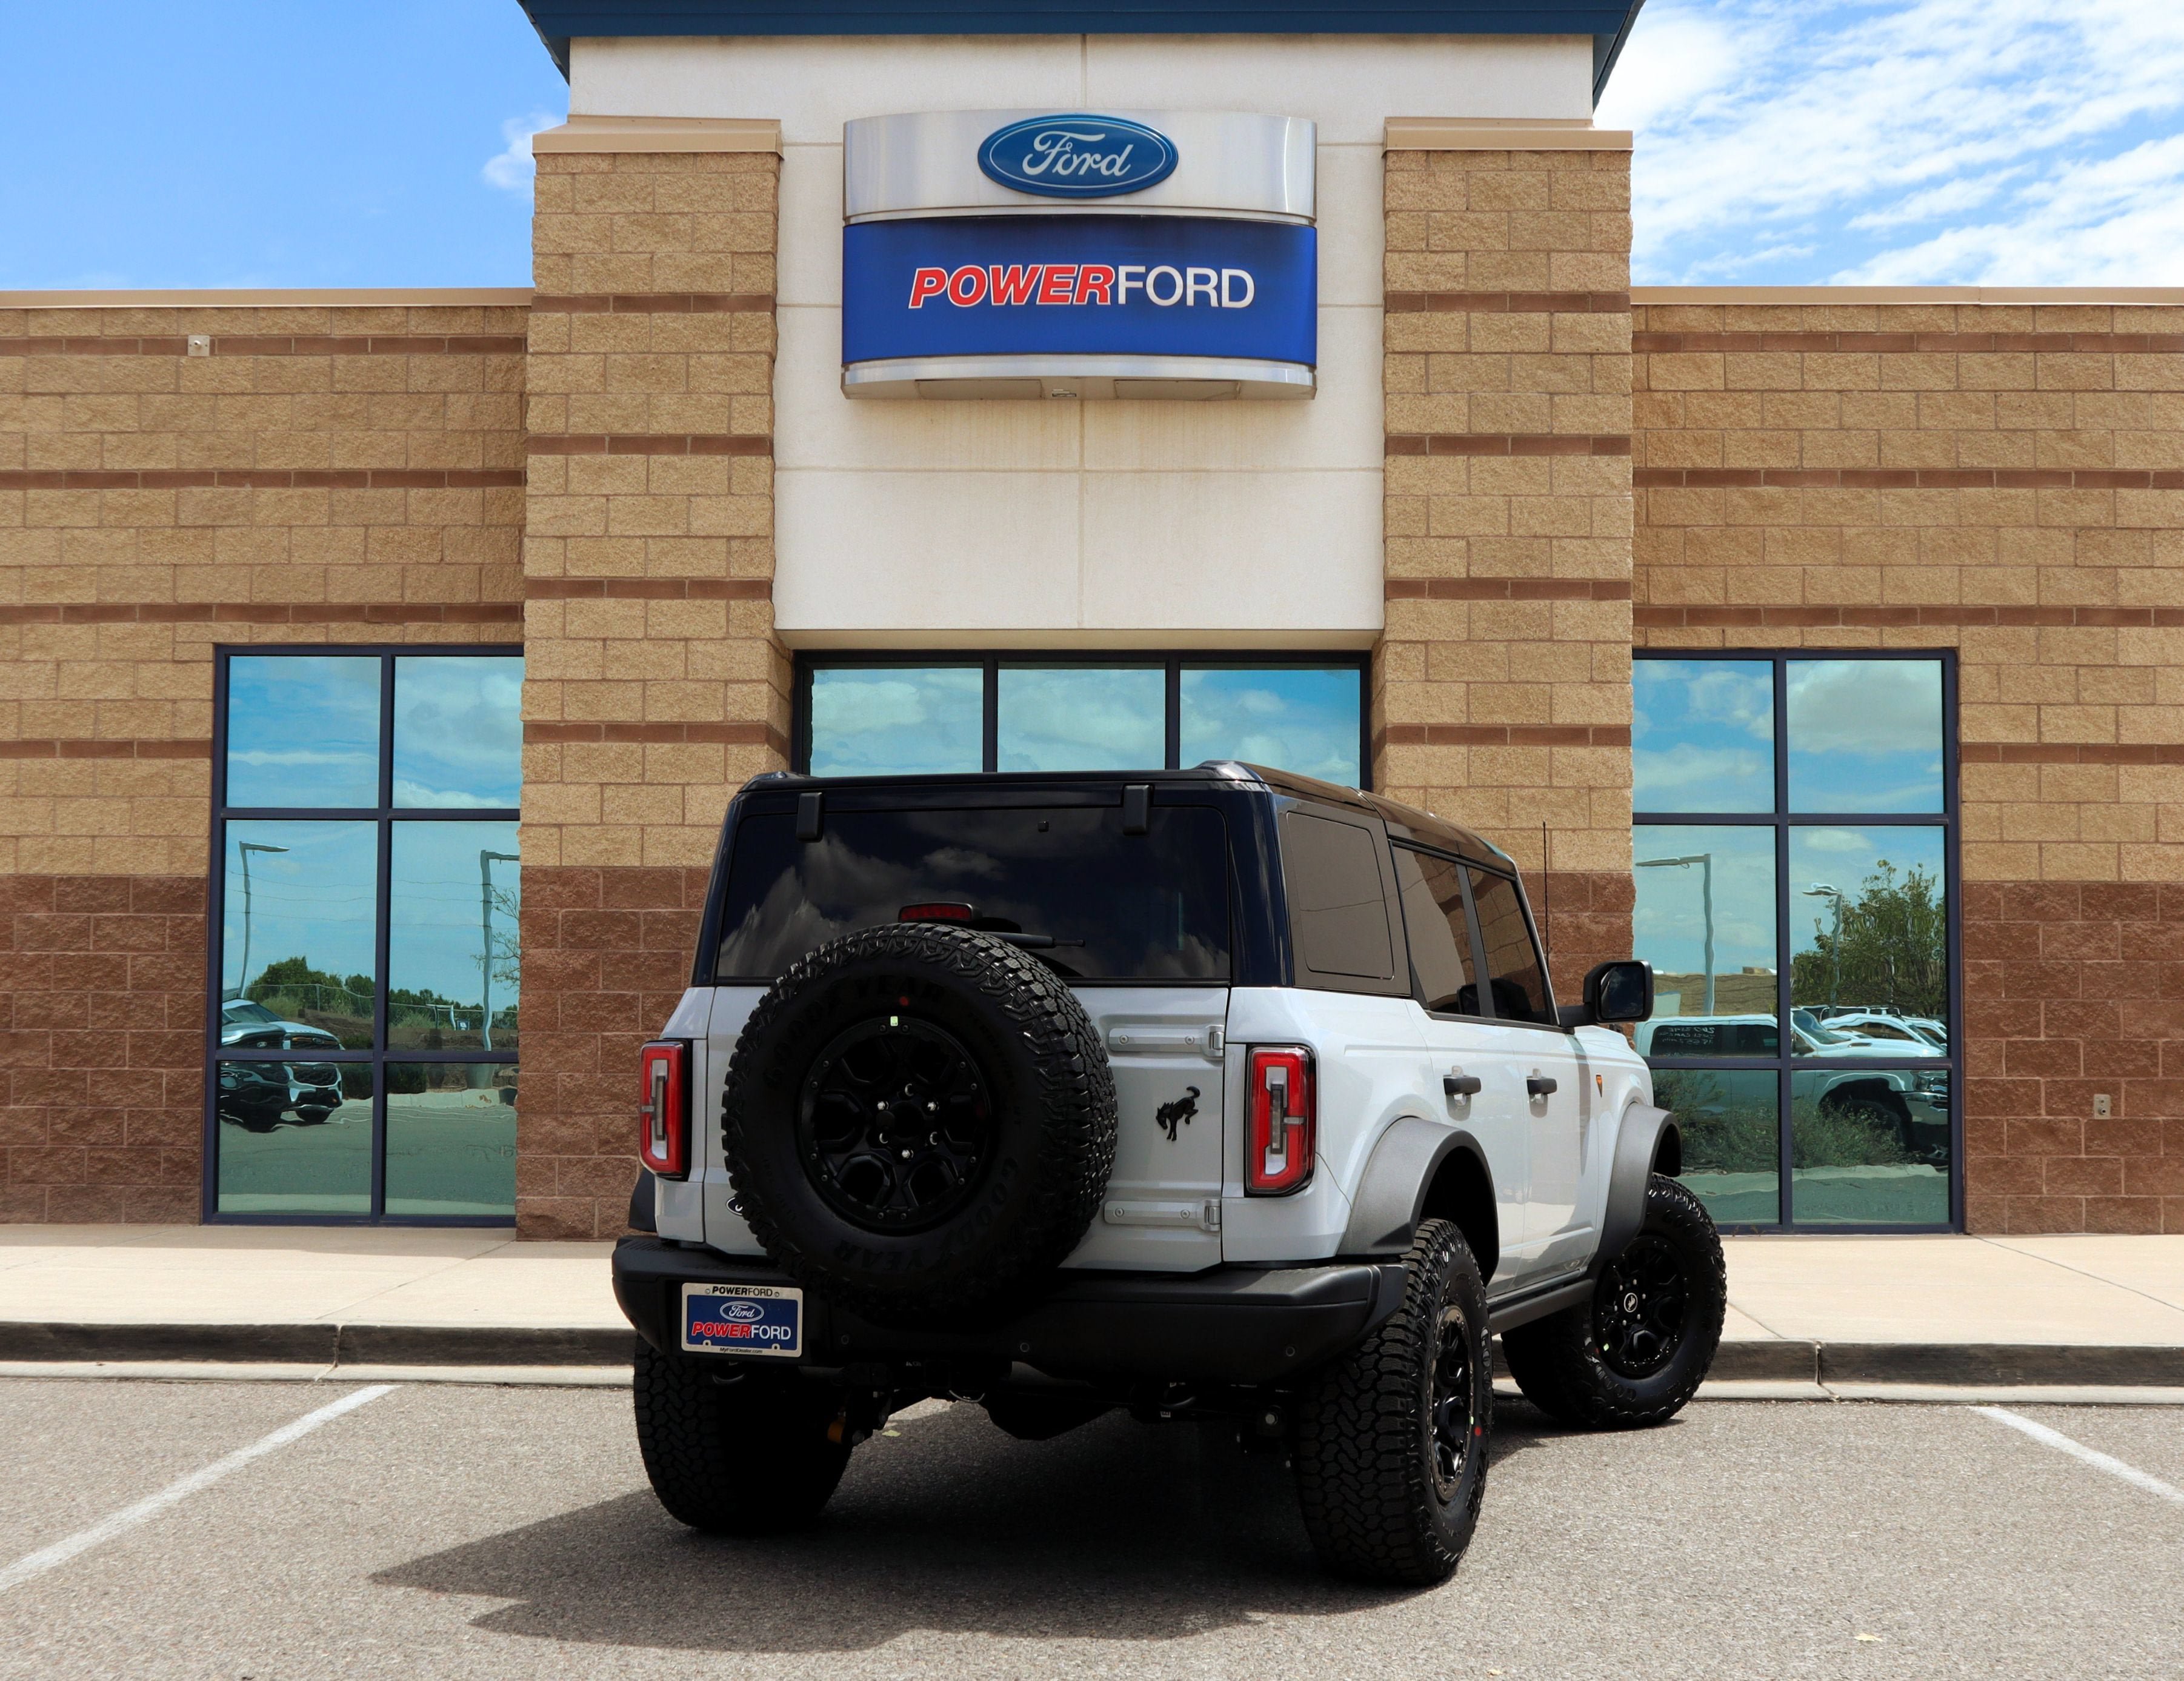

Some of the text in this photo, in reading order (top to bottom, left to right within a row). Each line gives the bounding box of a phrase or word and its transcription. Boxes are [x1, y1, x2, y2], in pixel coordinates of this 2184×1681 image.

[1022, 130, 1134, 177] Ford
[908, 263, 1256, 310] POWERFORD
[711, 1286, 773, 1297] POWERFORD
[728, 1304, 755, 1319] Ford
[691, 1321, 791, 1340] POWERFORD
